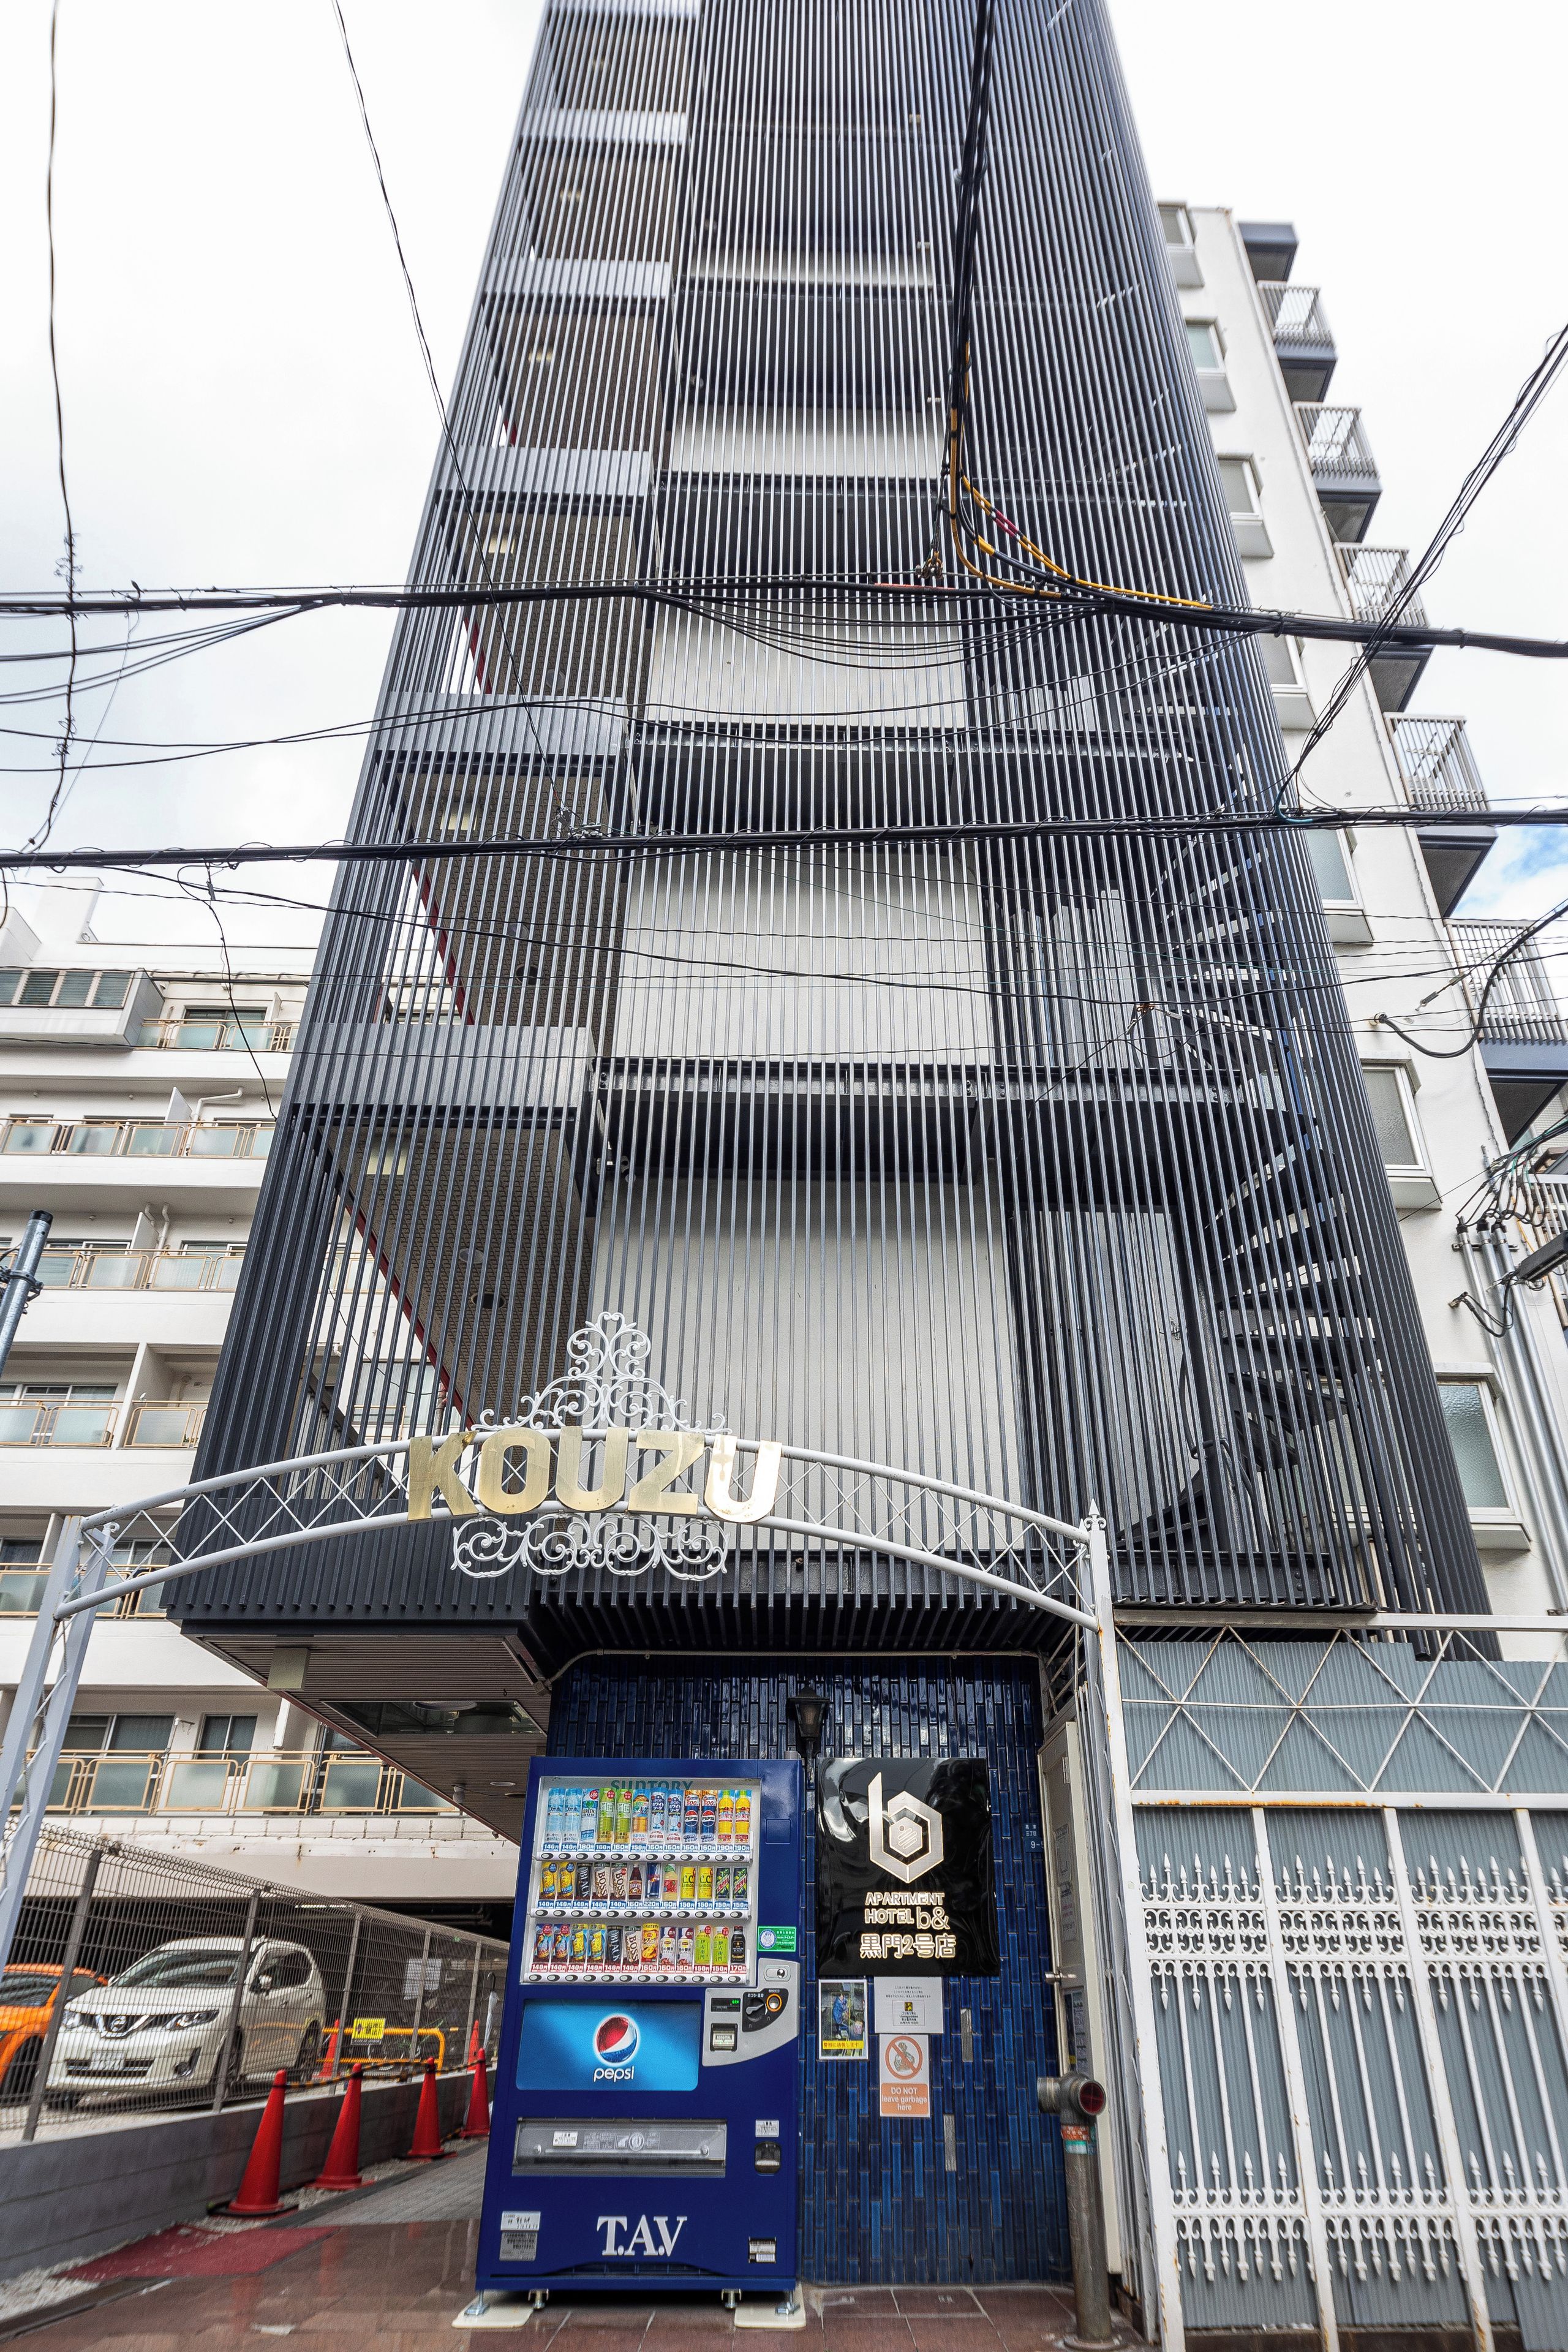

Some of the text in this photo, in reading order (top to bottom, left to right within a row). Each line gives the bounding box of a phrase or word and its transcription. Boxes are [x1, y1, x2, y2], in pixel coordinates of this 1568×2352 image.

[407, 1426, 783, 1522] KOUZU
[580, 1870, 590, 1898] BLACK
[598, 1871, 608, 1896] BOSS
[616, 1872, 625, 1896] BOSS
[864, 1892, 945, 1906] APARTMENT
[864, 1906, 951, 1930] HOTEL b&
[610, 1933, 620, 1961] BLACK
[629, 1936, 639, 1961] BOSS
[859, 1932, 957, 1959] 黒門2号店
[593, 2066, 635, 2082] pepsi
[897, 2103, 912, 2111] here
[900, 2095, 927, 2105] garbage
